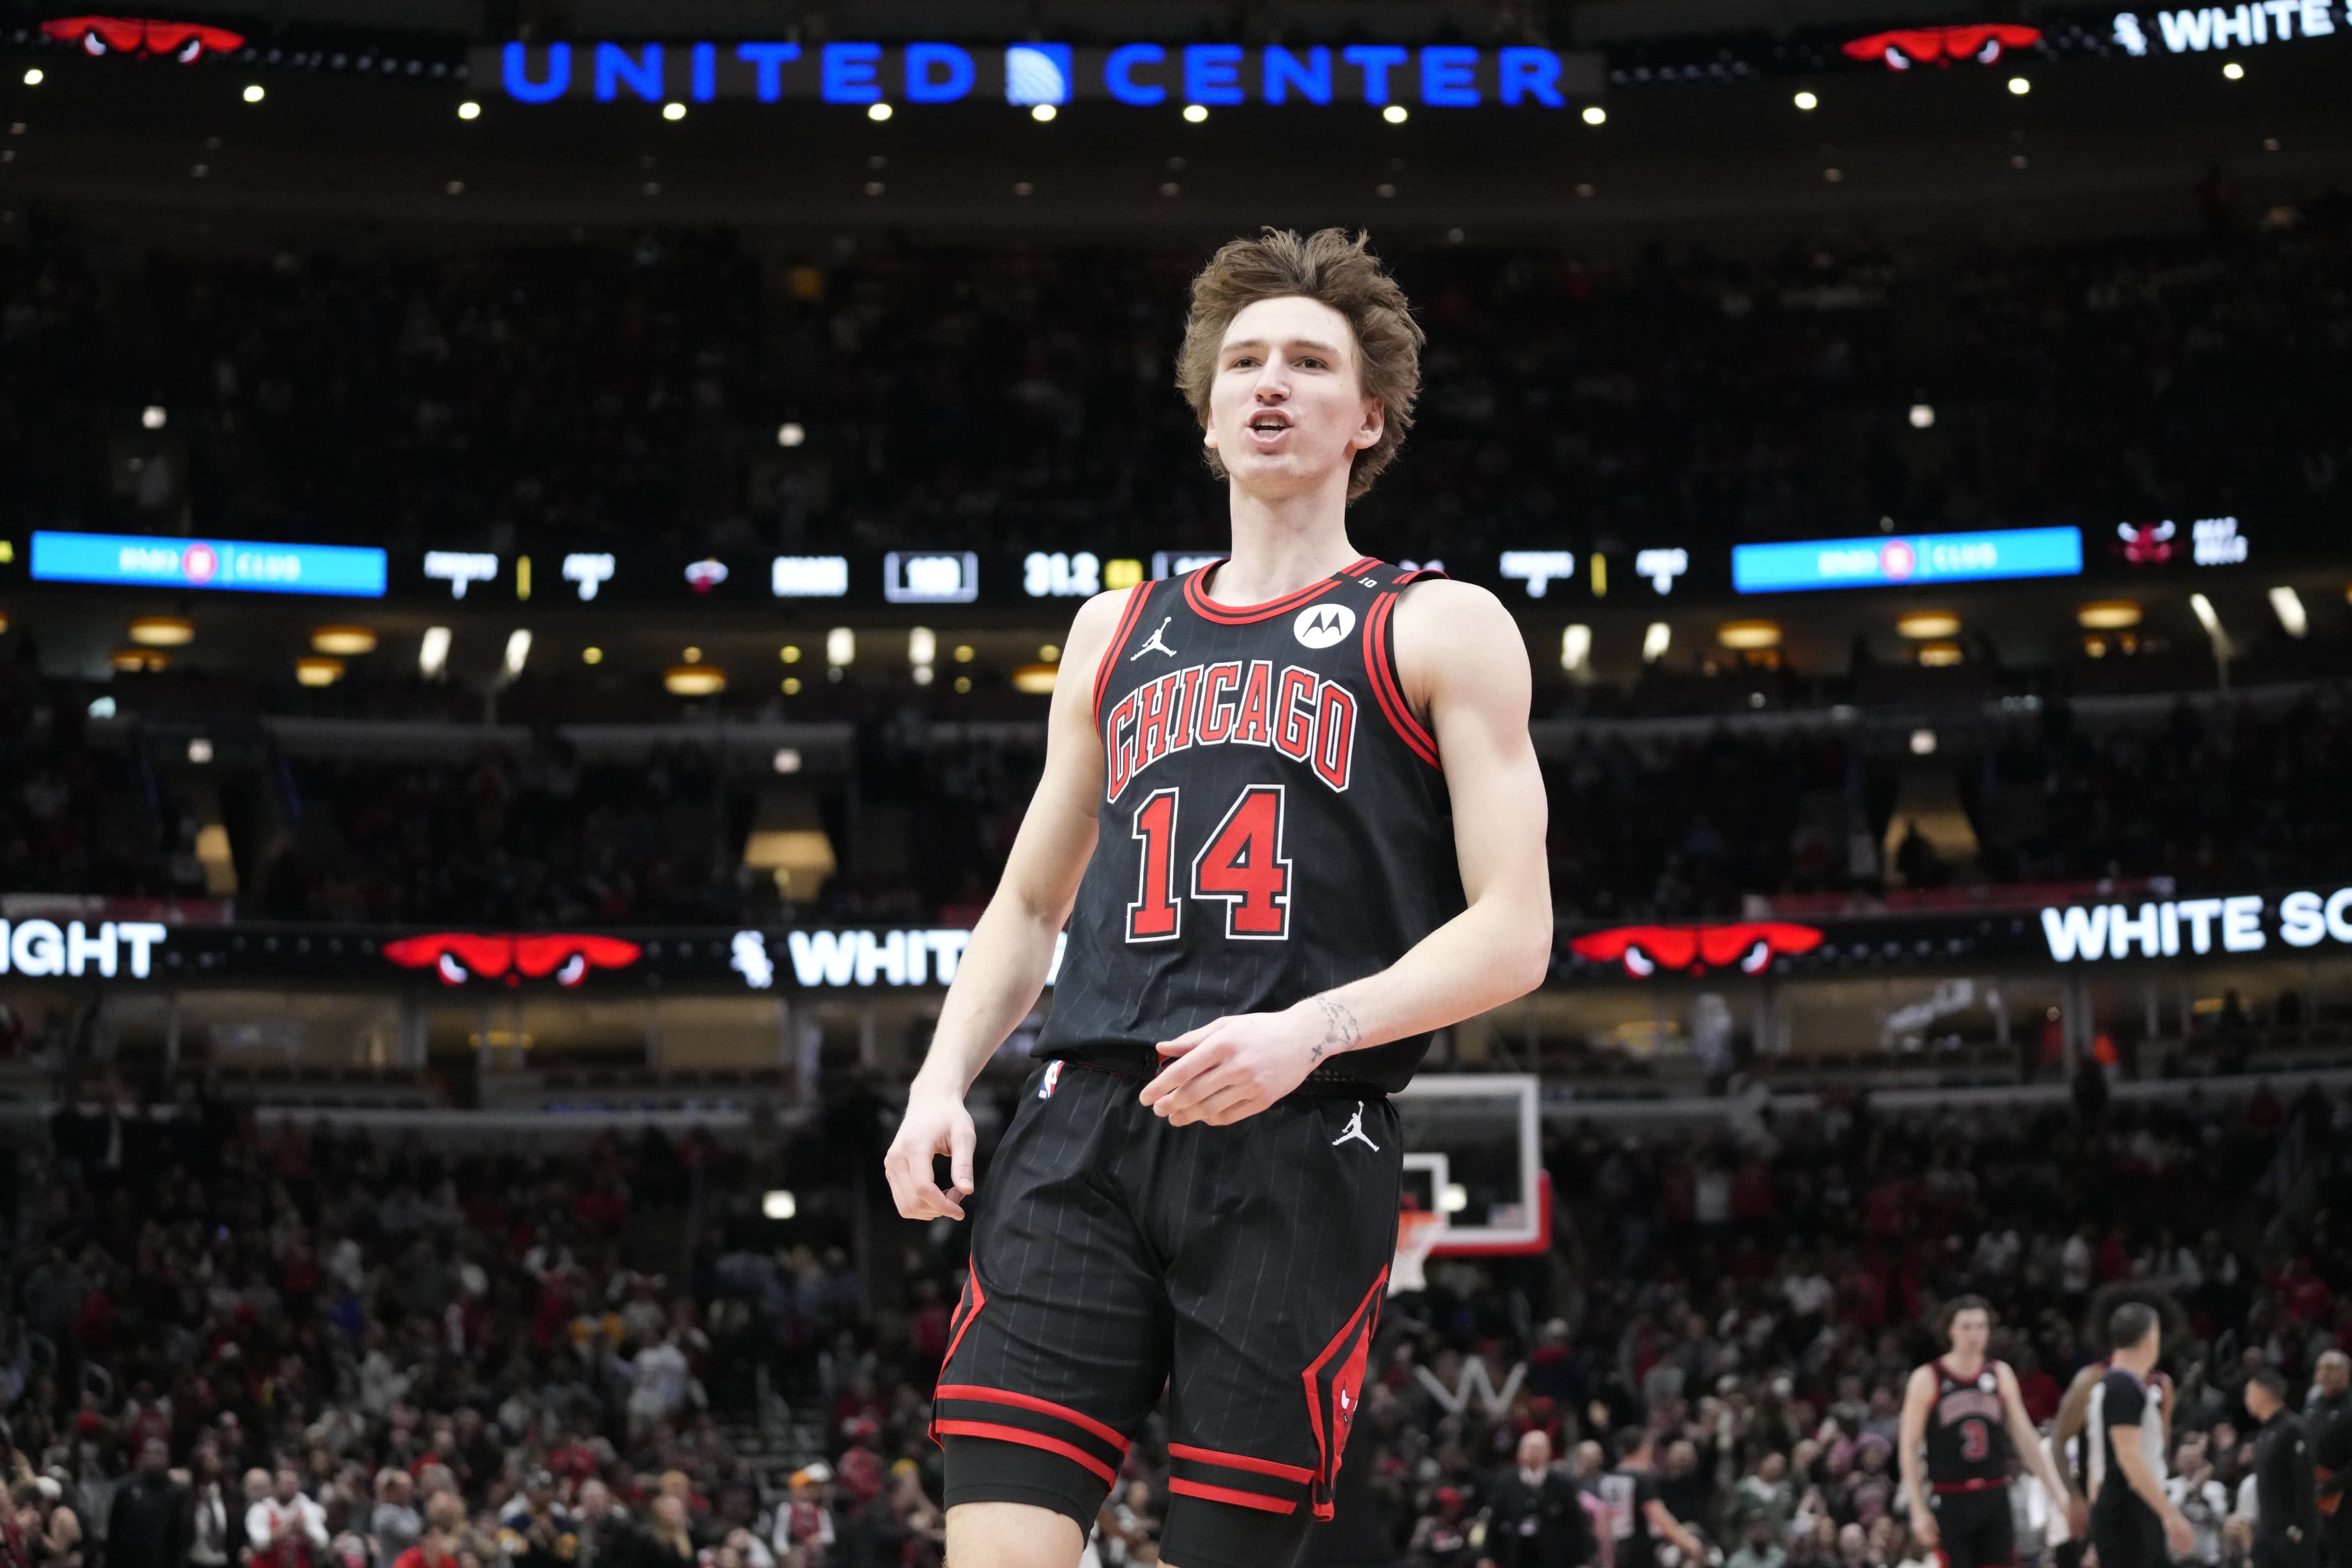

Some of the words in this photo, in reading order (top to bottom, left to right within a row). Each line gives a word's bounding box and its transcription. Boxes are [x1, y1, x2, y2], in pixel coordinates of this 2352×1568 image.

[2158, 0, 2335, 52] WHITE
[502, 42, 977, 104] UNITED
[1103, 43, 1566, 108] CENTER
[1358, 577, 1377, 588] 10
[1108, 660, 1358, 803] CHICAGO
[1126, 784, 1292, 943] 14
[788, 930, 973, 986] WHIT
[2041, 895, 2266, 962] WHITE
[1960, 1418, 1990, 1461] 3
